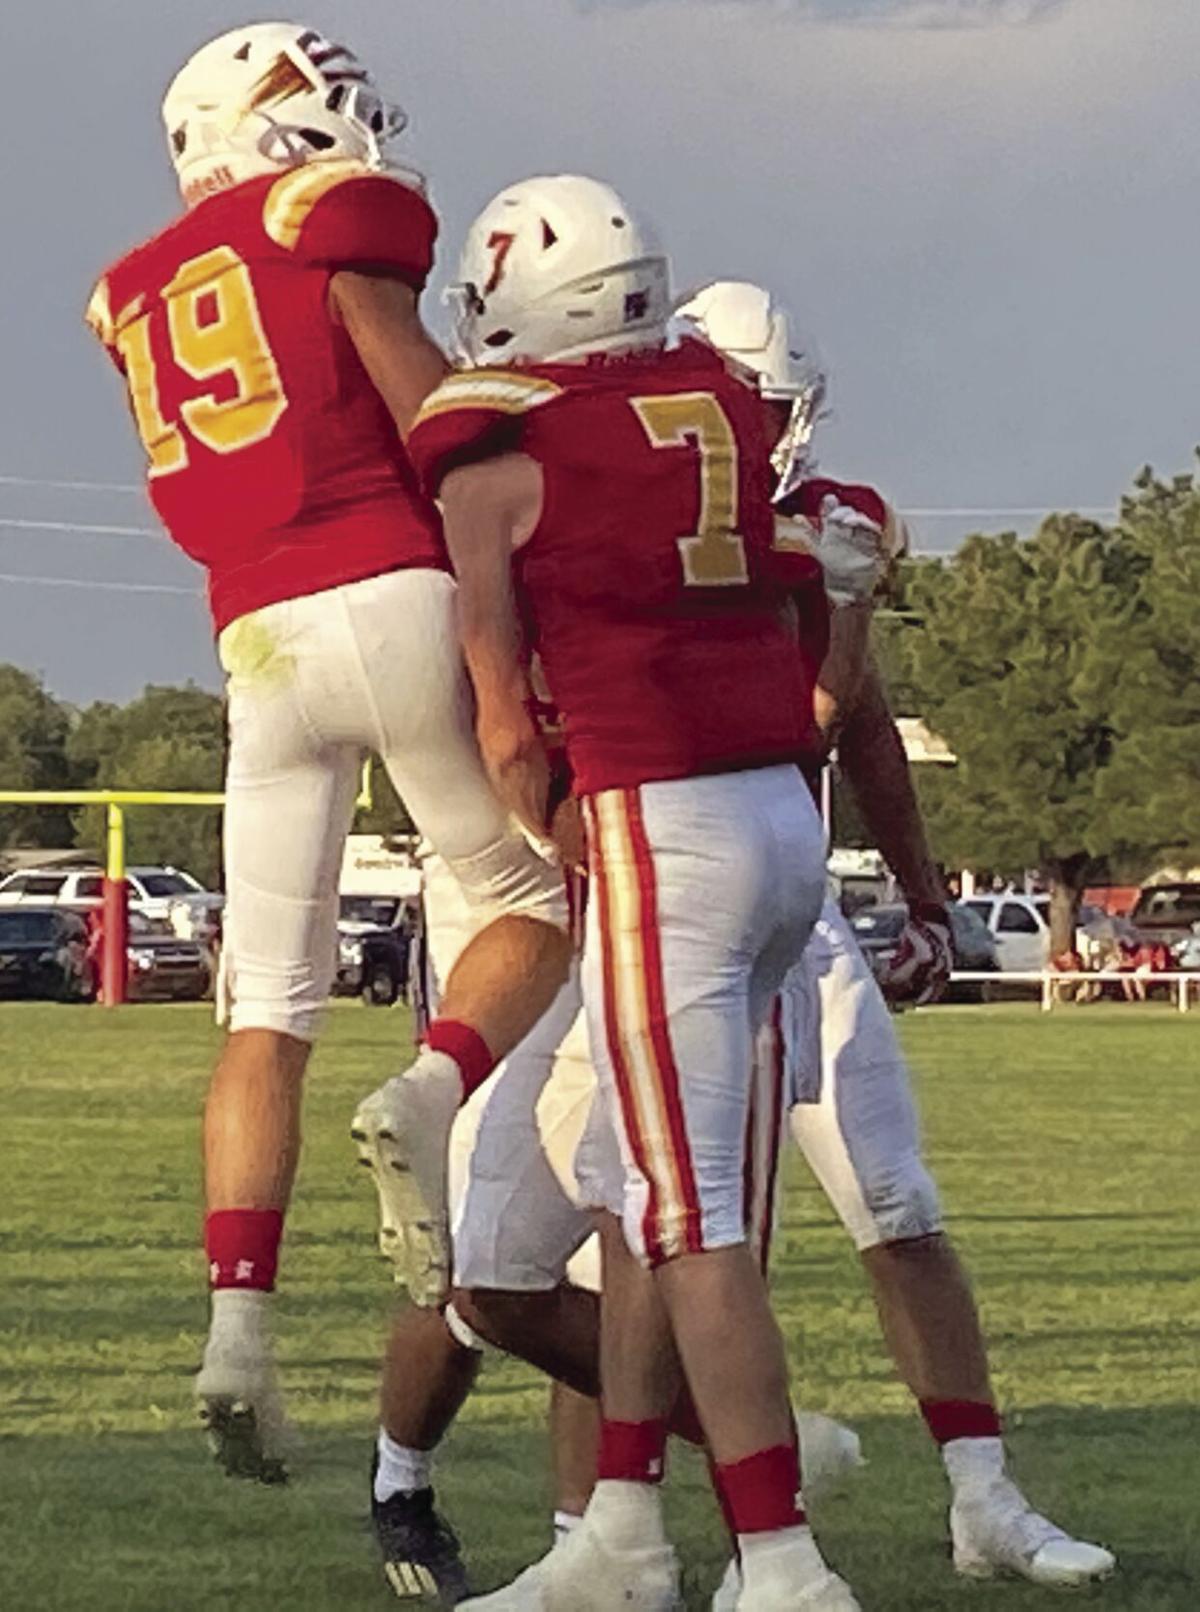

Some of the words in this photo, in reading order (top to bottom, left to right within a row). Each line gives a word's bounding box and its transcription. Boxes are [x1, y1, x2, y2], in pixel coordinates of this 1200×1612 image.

[485, 231, 517, 297] 7
[114, 246, 288, 478] 19
[630, 392, 750, 587] 7
